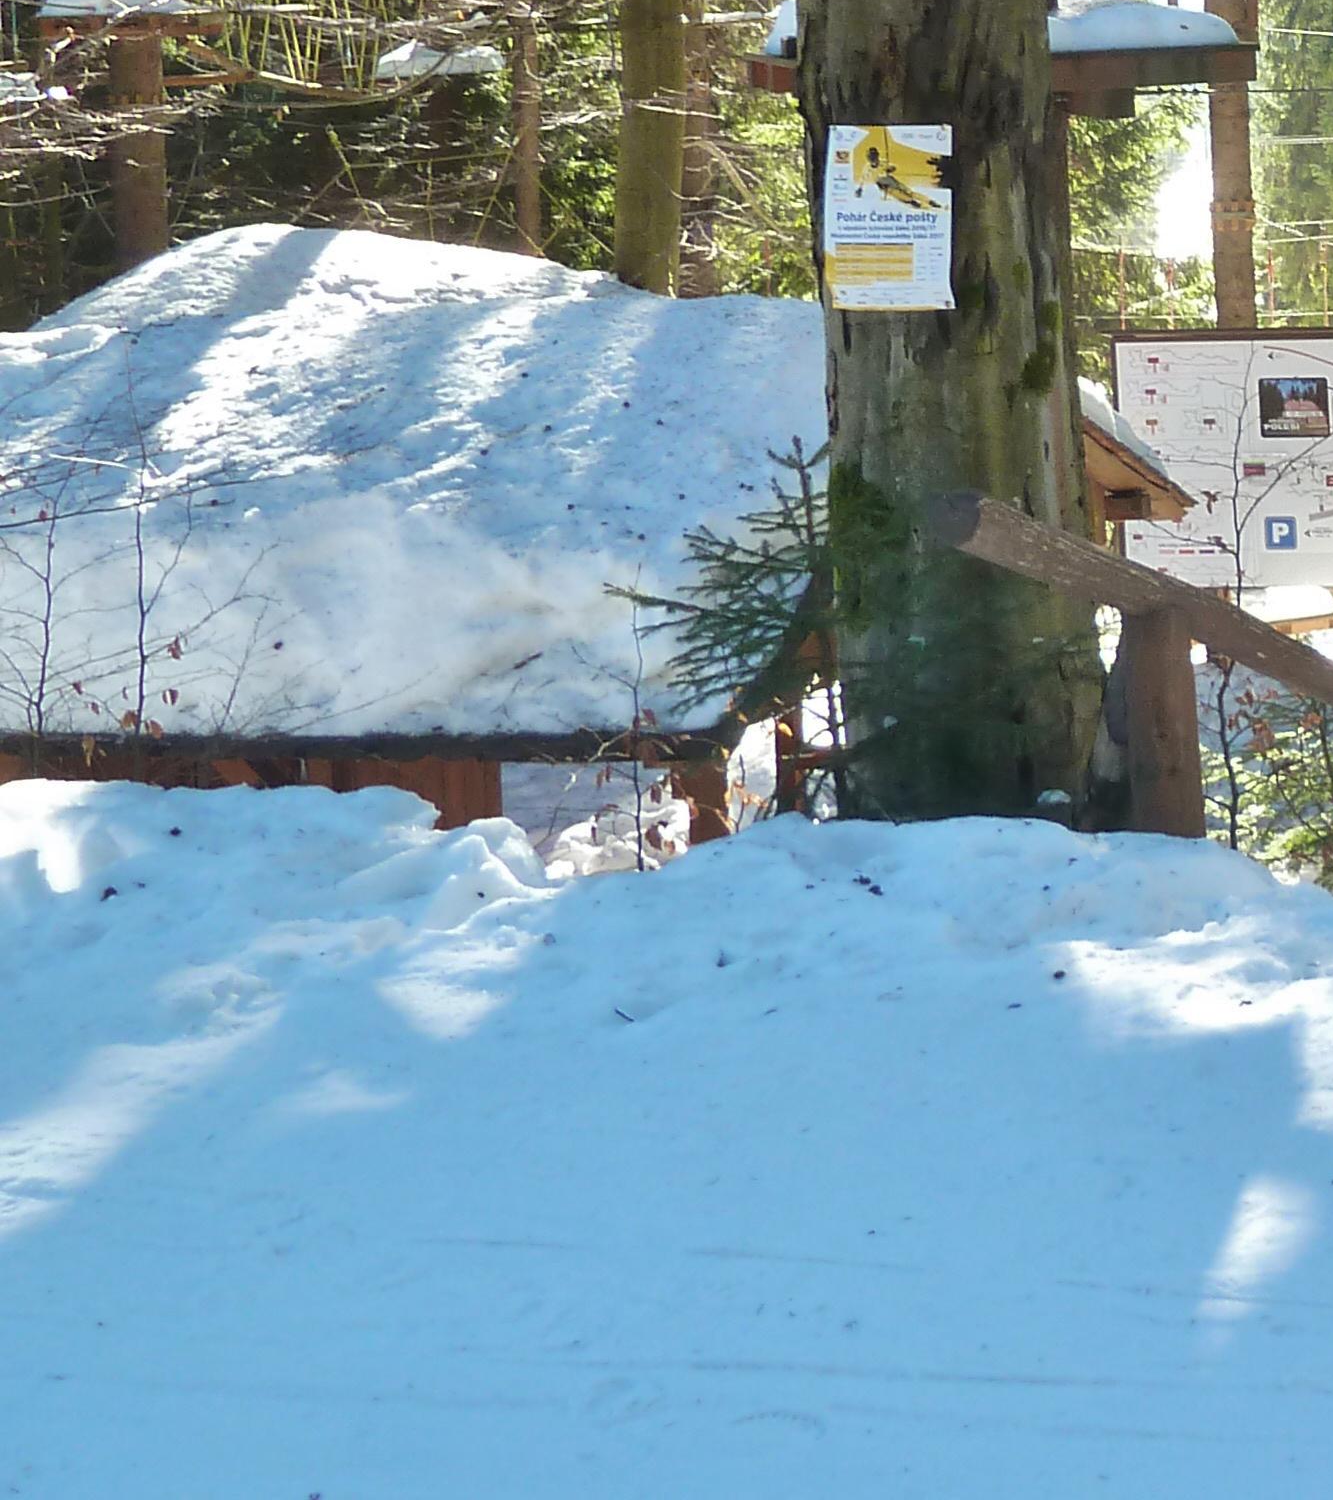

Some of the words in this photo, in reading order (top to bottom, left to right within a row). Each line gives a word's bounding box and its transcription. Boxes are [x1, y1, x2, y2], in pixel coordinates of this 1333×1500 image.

[836, 211, 866, 222] Pohár
[870, 210, 903, 222] České
[906, 211, 938, 223] pošty
[1272, 522, 1289, 543] P
